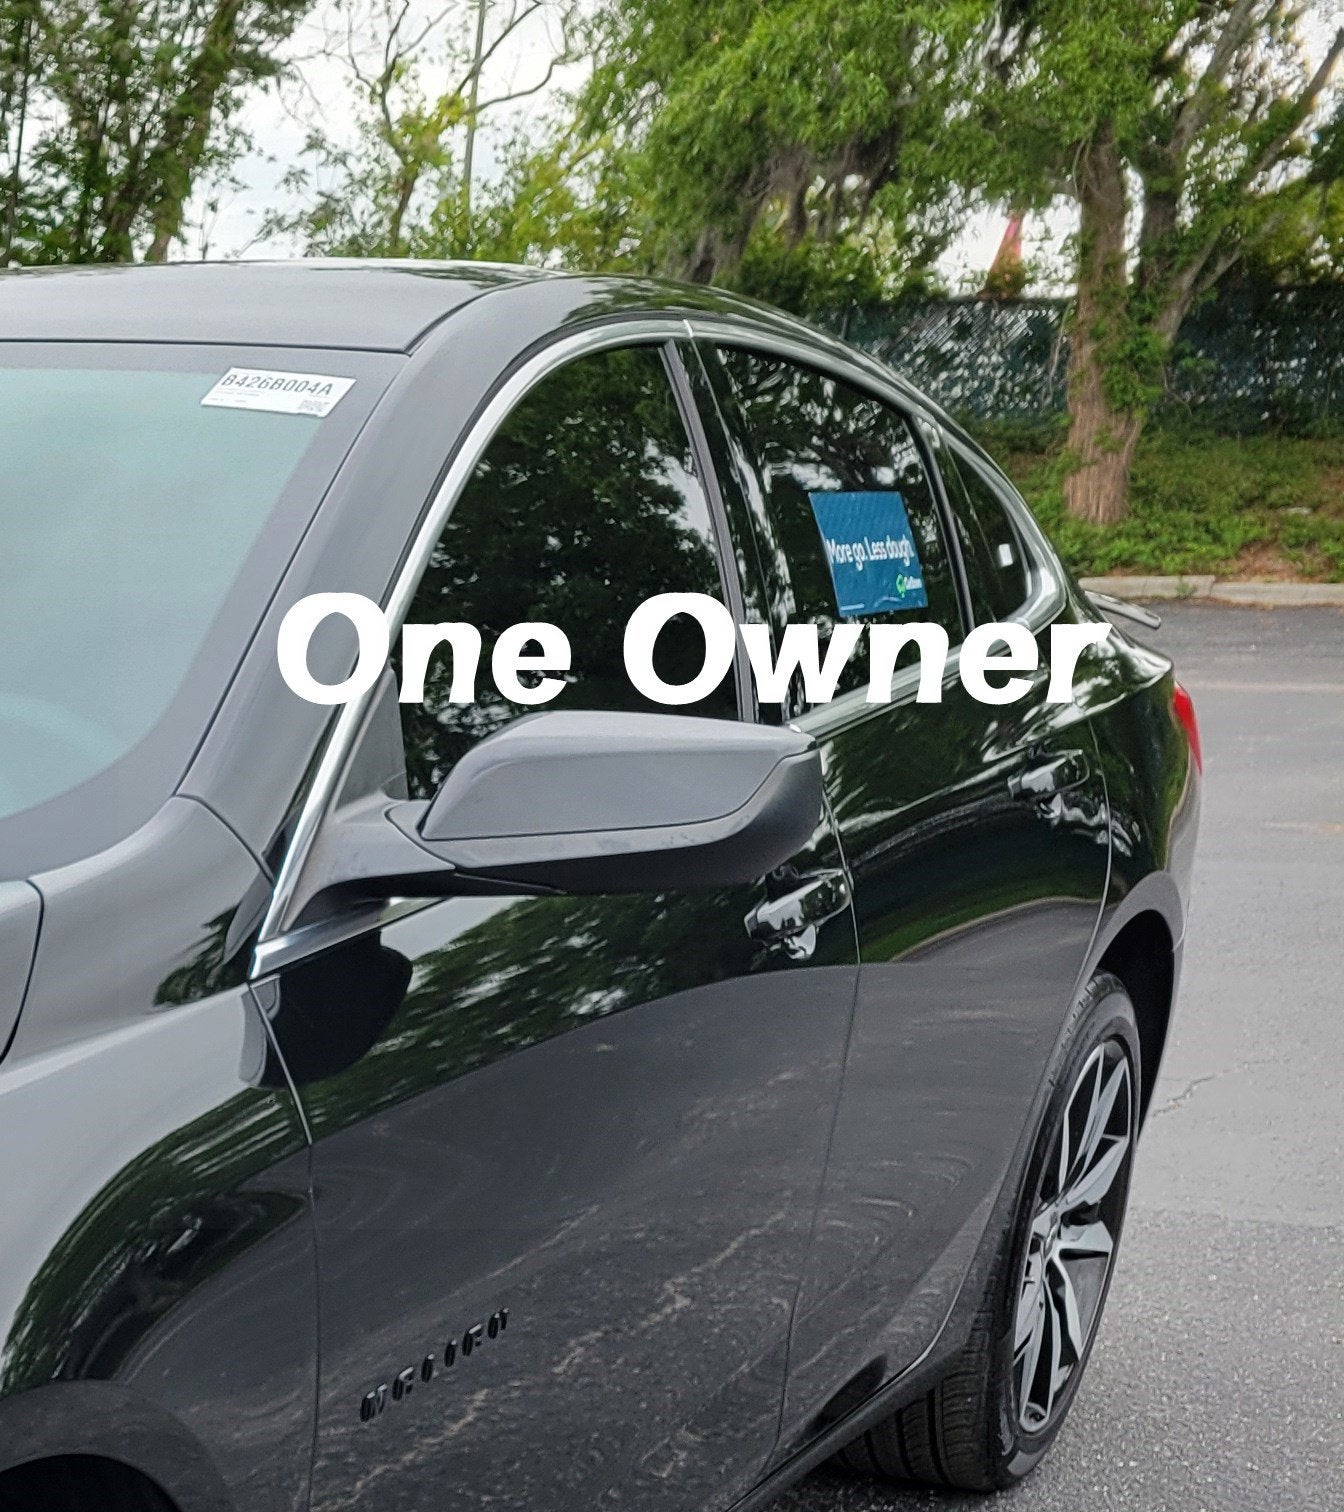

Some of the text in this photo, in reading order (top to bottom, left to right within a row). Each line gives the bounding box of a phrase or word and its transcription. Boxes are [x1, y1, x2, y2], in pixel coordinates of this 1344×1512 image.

[221, 374, 334, 396] B426B004A
[826, 533, 914, 571] More go. Less dough.
